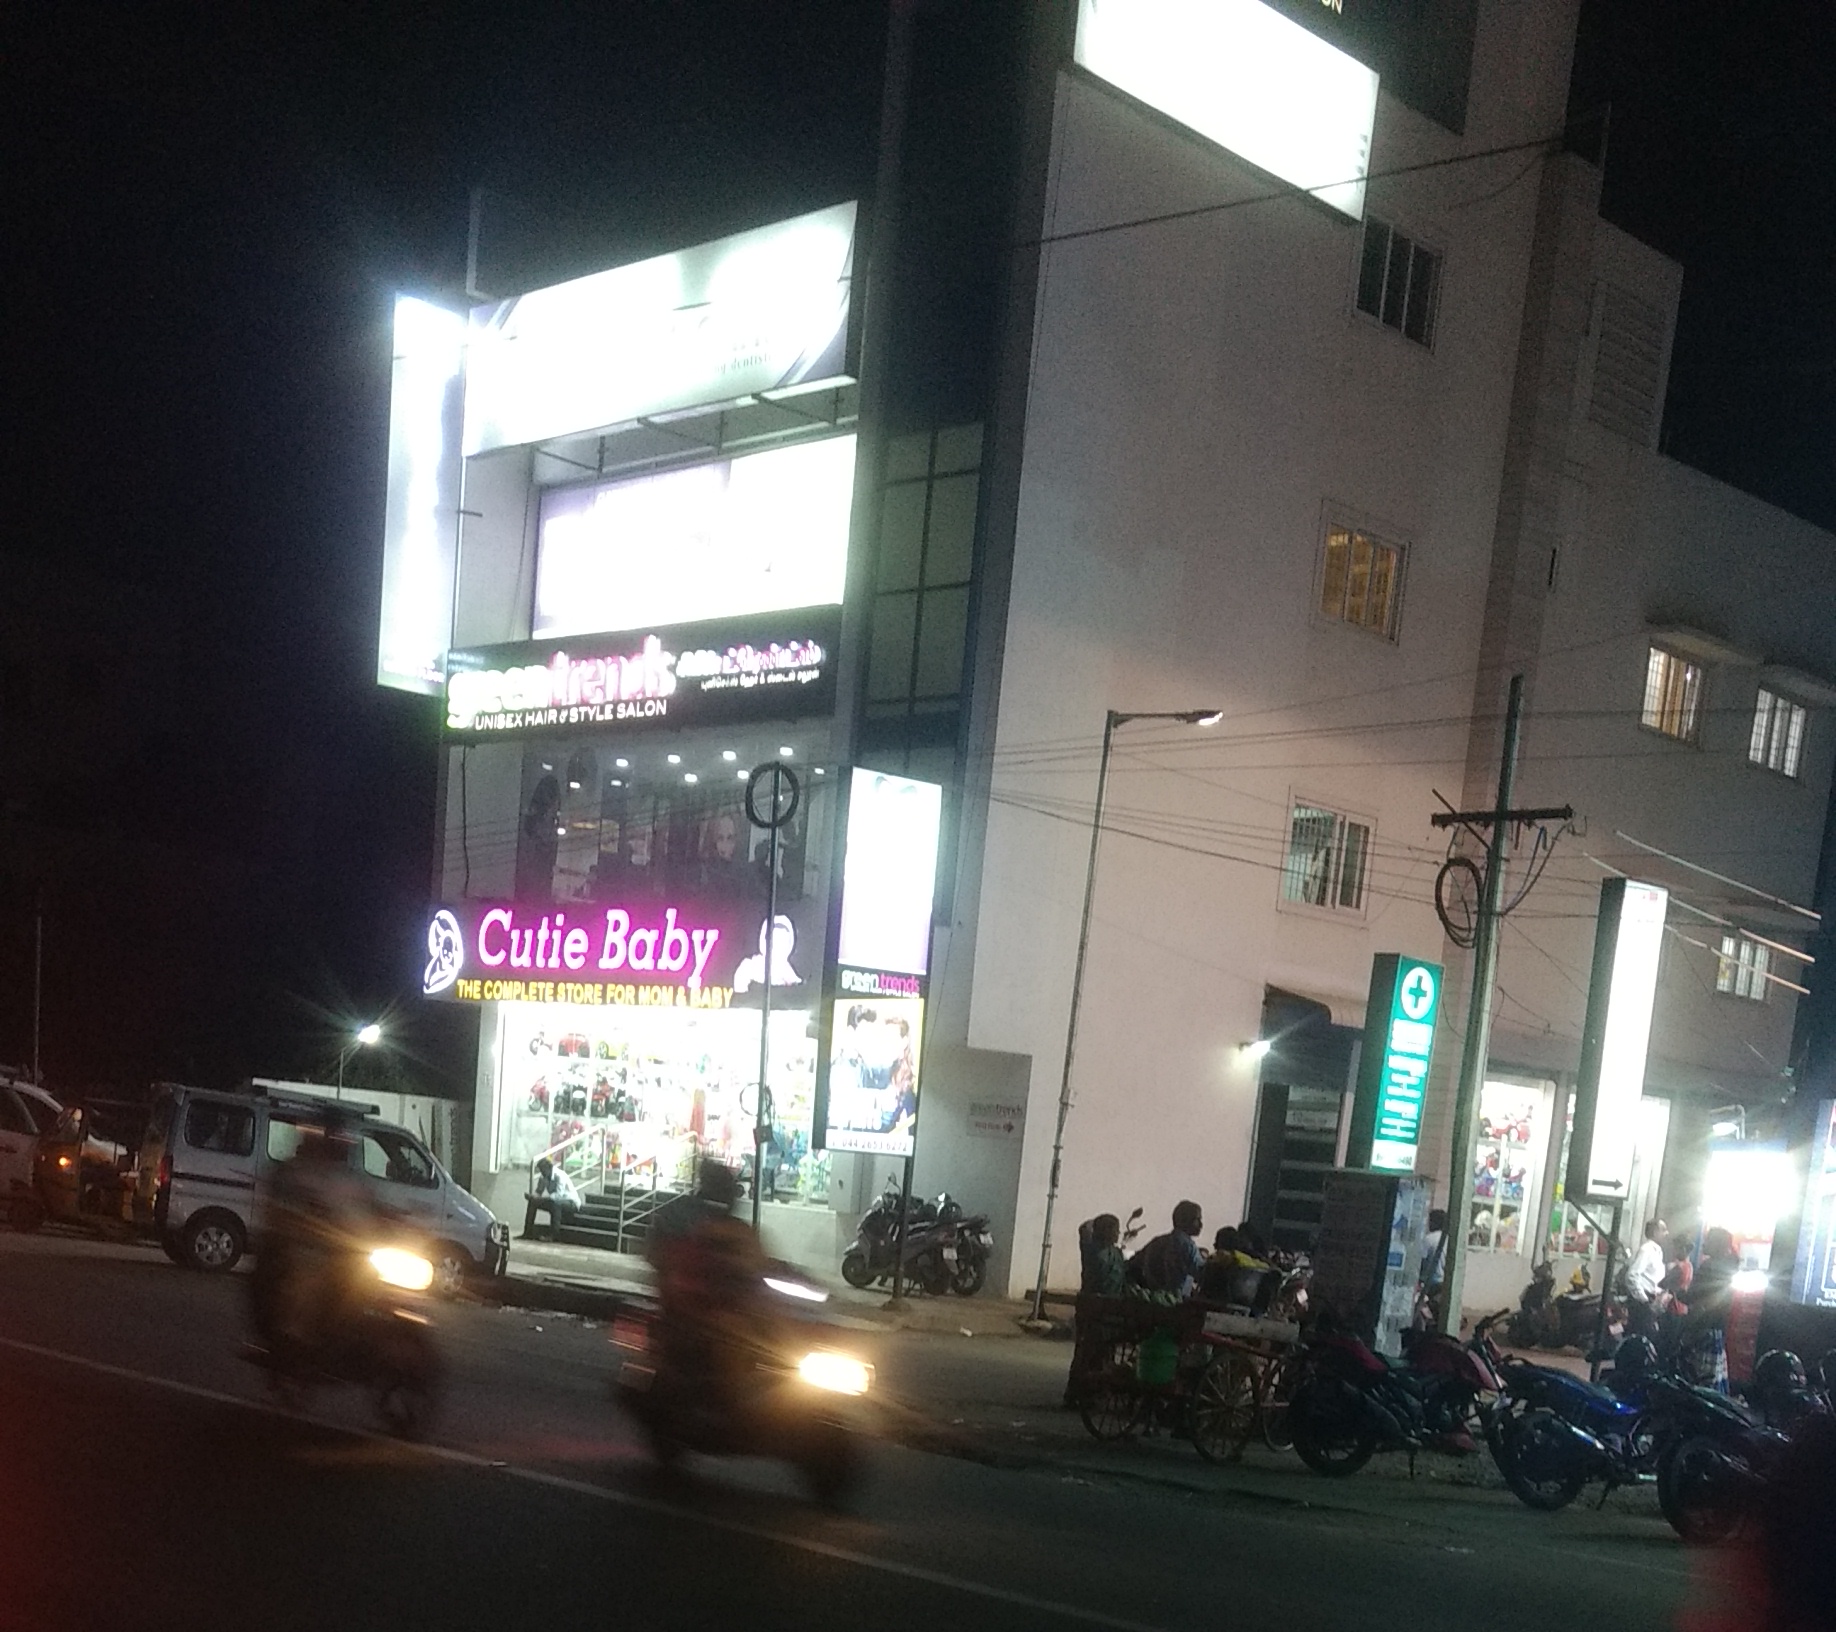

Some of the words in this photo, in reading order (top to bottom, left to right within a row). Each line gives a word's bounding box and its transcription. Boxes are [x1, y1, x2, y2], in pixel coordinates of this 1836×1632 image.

[475, 711, 522, 730] UNISEX
[525, 708, 557, 728] HAIR
[569, 704, 614, 723] STYLE
[616, 699, 668, 718] SALON
[478, 907, 589, 970] Cutie
[598, 907, 719, 989] Baby
[457, 979, 482, 1000] THE
[484, 980, 554, 1002] COMPLETE
[557, 982, 603, 1003] STORE
[606, 984, 636, 1005] FOR
[638, 985, 674, 1006] MOM
[676, 986, 687, 1007] &
[690, 986, 734, 1009] BABY
